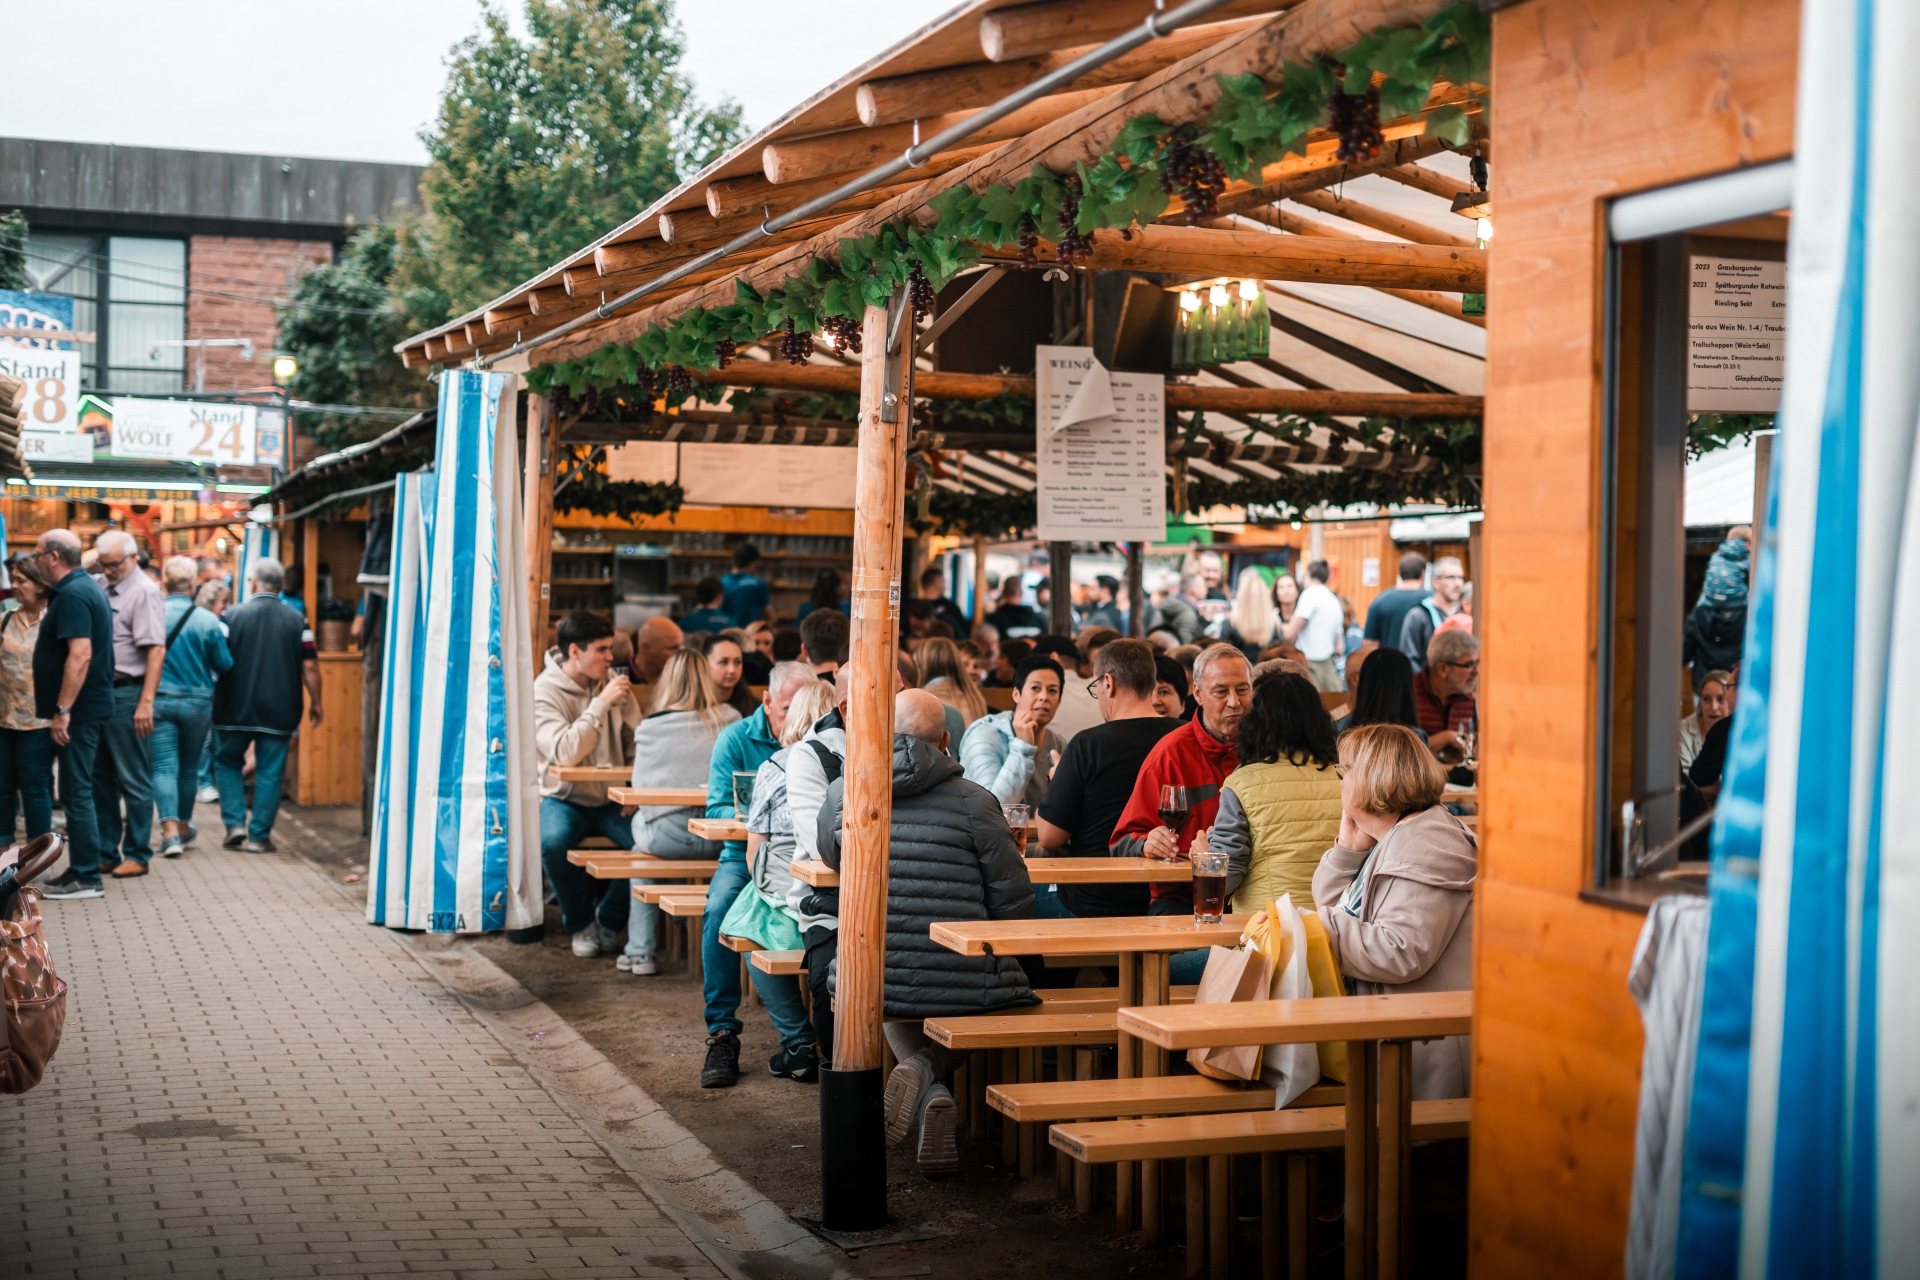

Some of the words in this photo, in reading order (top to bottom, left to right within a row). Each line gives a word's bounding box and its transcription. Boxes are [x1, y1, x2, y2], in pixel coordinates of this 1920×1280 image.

[1717, 264, 1763, 273] Grauburgunder
[1715, 282, 1759, 290] Spätburgunder
[1714, 300, 1739, 308] Riesling
[1692, 341, 1733, 349] Trollschoppen
[1735, 342, 1771, 350] (Wein+Sekt)
[0, 358, 65, 380] Stand
[1050, 358, 1094, 370] WEING
[189, 406, 245, 424] Stand
[118, 430, 174, 447] WOLF
[187, 420, 245, 459] 24
[24, 439, 45, 453] ER
[35, 485, 57, 497] IST
[65, 487, 98, 498] JEDE
